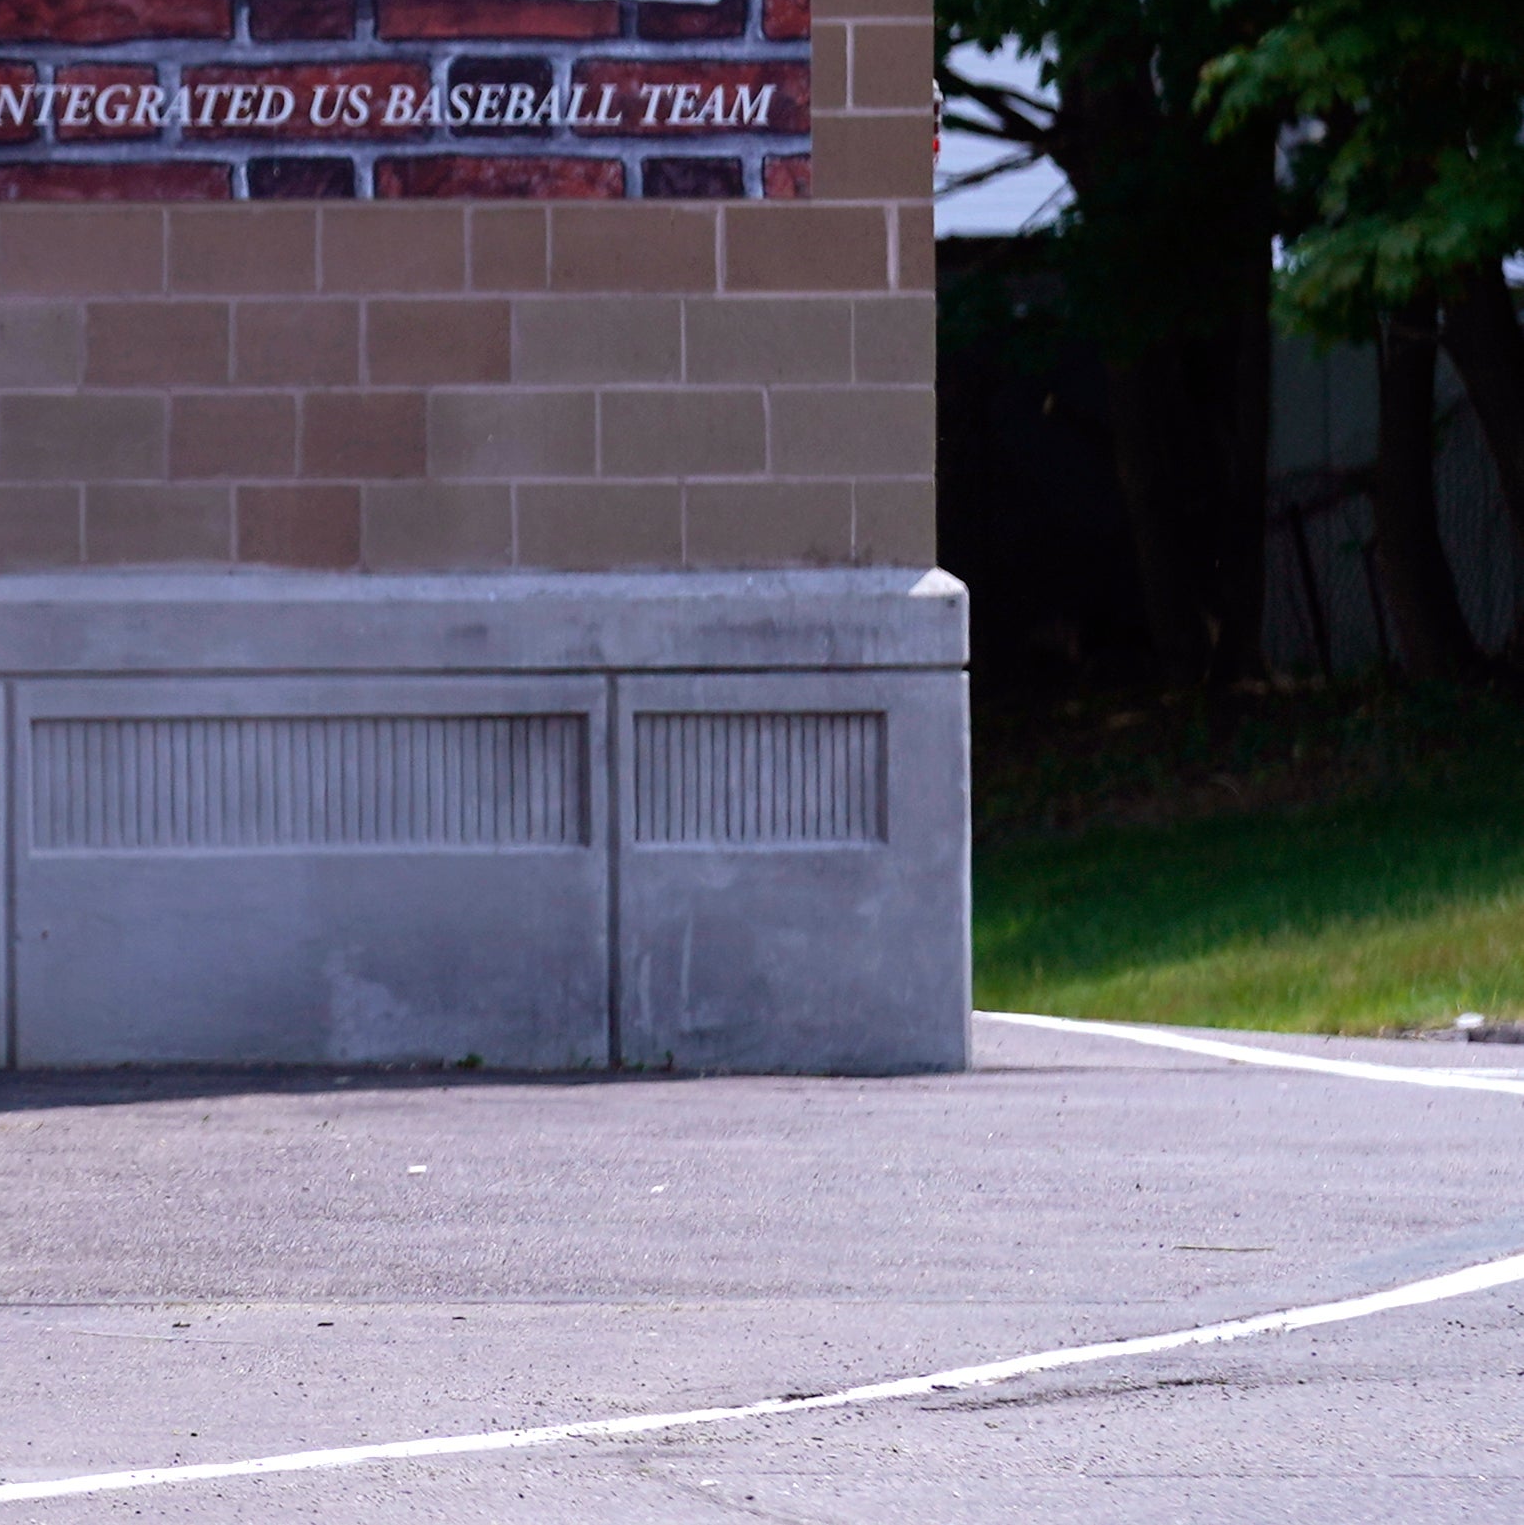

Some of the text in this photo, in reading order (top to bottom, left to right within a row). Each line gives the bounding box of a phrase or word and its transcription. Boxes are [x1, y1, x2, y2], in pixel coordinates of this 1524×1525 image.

[308, 83, 373, 128] US
[381, 83, 624, 128] BASEBALL
[638, 83, 778, 128] TEAM
